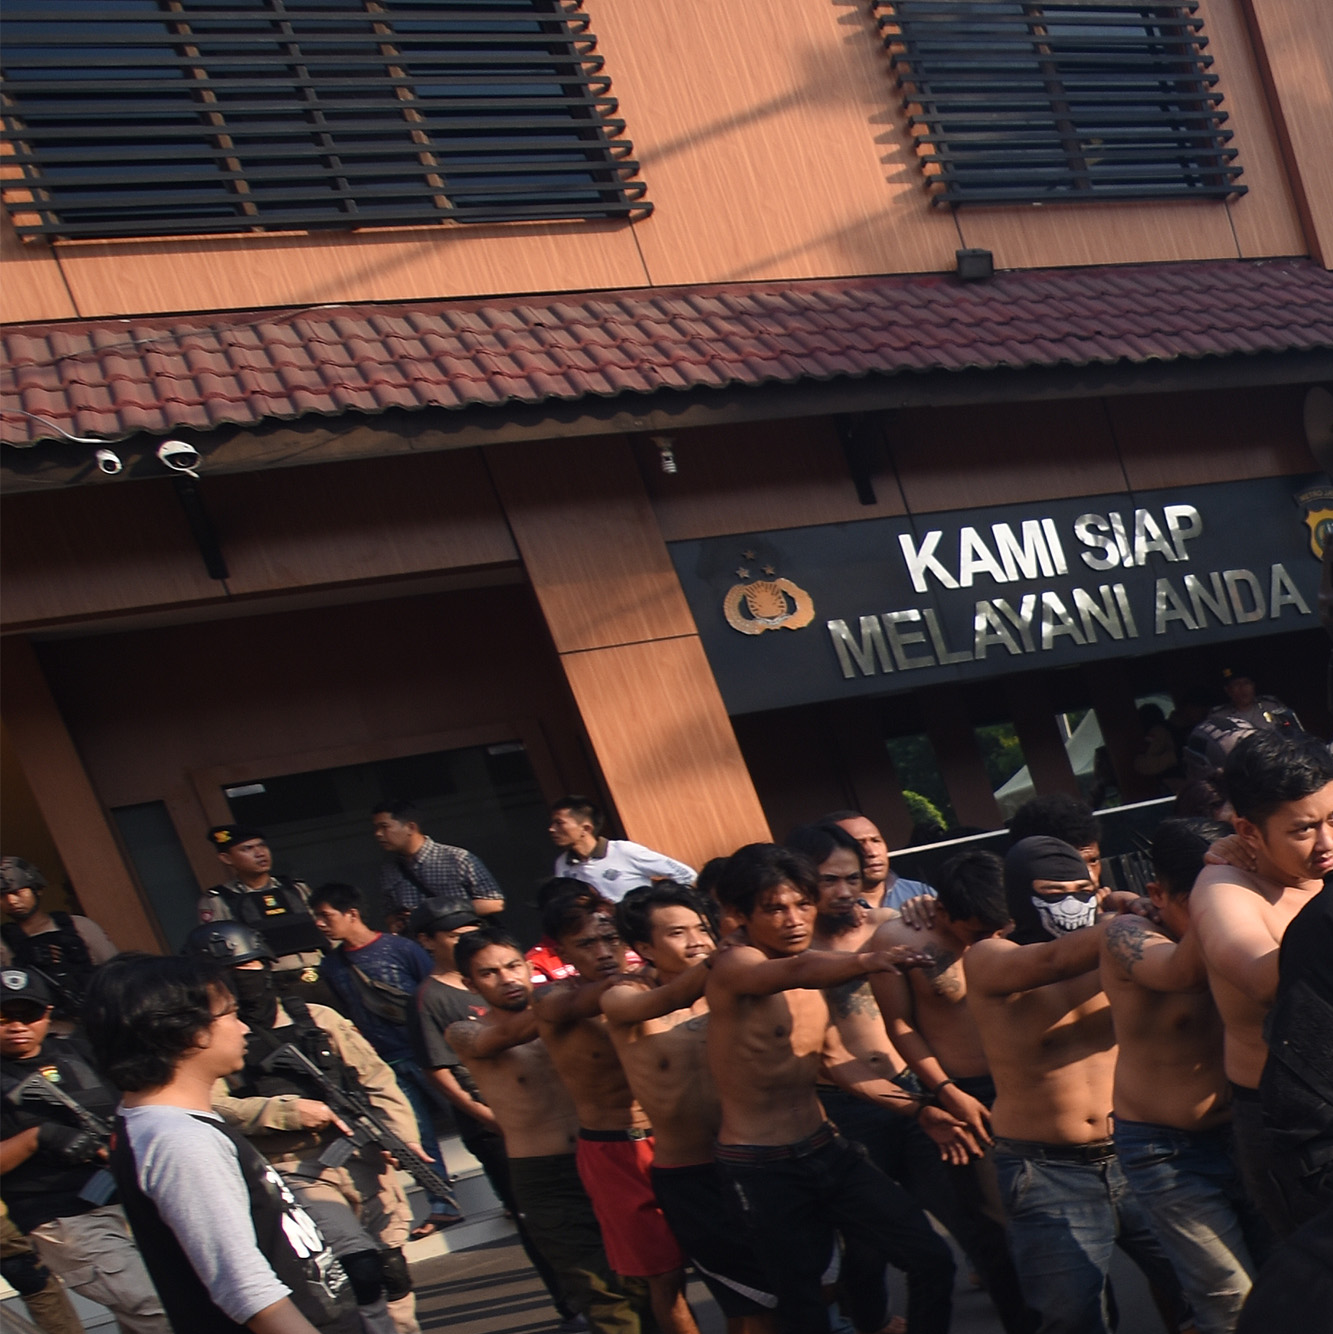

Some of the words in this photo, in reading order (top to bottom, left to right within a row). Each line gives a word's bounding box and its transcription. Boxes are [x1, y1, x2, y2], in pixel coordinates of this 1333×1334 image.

[899, 517, 1068, 593] KAMI
[1074, 504, 1202, 571] SIAP
[826, 583, 1138, 679] MELAYANI
[1155, 563, 1311, 635] ANDA
